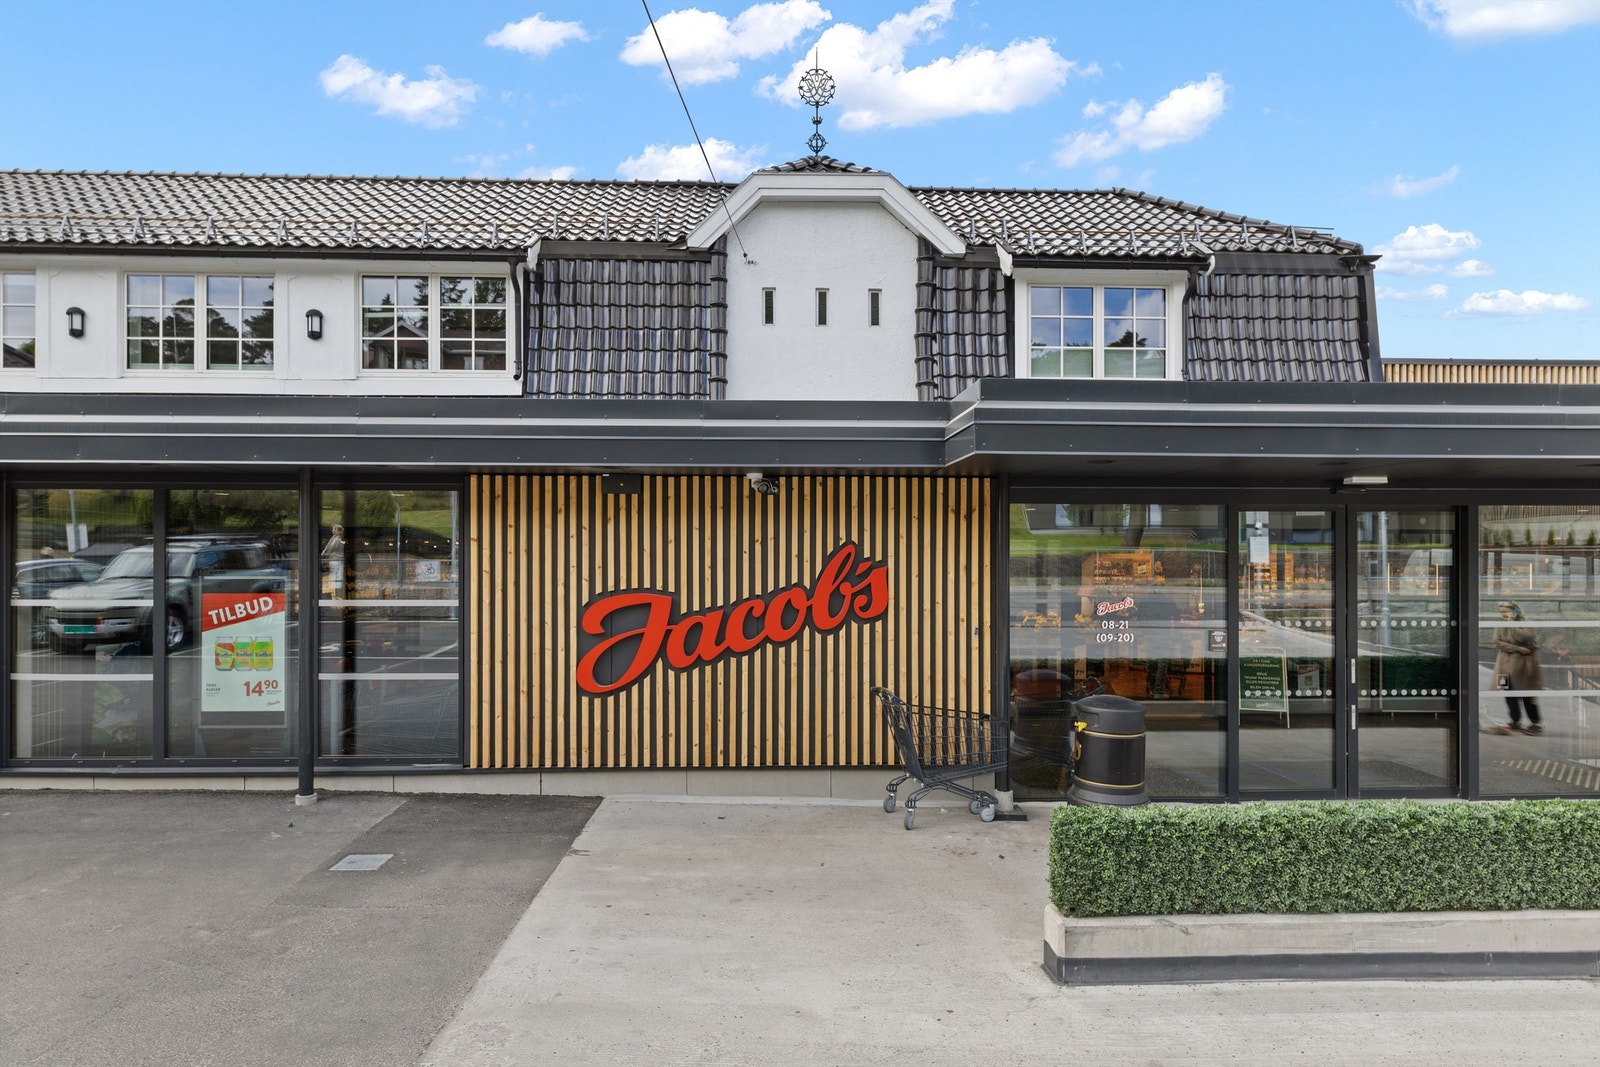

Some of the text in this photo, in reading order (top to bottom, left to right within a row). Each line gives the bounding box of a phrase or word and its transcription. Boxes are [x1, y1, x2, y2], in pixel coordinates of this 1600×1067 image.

[207, 596, 273, 625] TILBUD
[1096, 596, 1134, 616] Jacob's
[576, 545, 889, 692] Jacob's
[1101, 620, 1129, 629] 08-21
[1096, 633, 1134, 643] (09-20)
